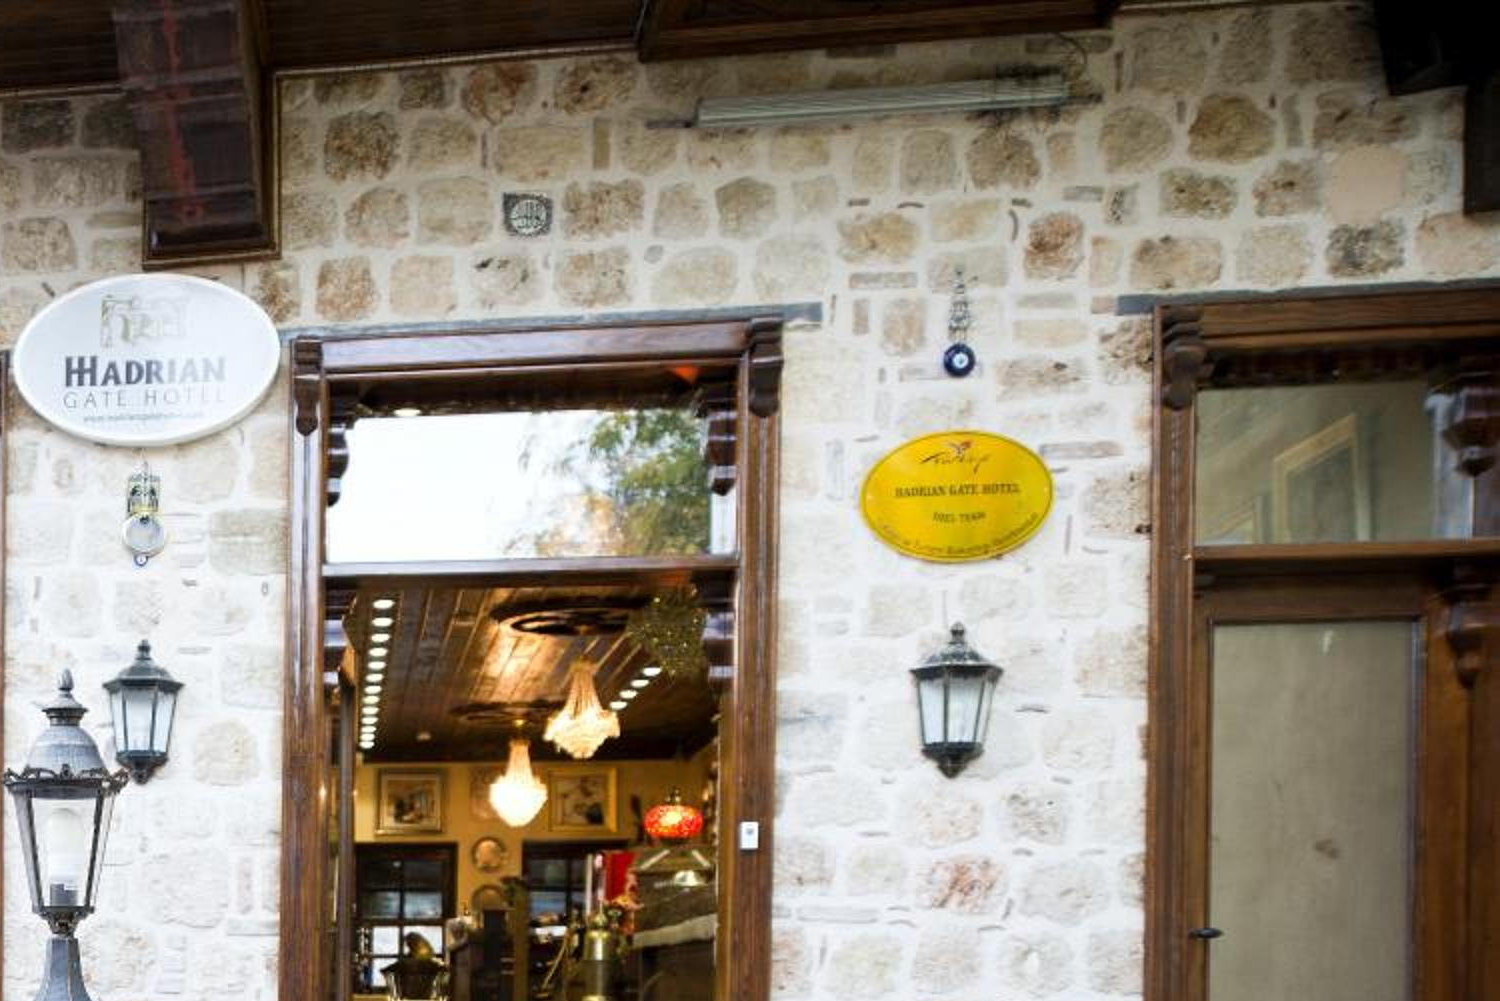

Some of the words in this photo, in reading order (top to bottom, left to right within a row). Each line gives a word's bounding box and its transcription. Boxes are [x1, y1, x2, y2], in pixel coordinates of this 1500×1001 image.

[63, 390, 127, 409] GATE
[145, 387, 225, 406] HOTEL
[949, 484, 979, 495] GATE
[981, 483, 1020, 494] HOTEL
